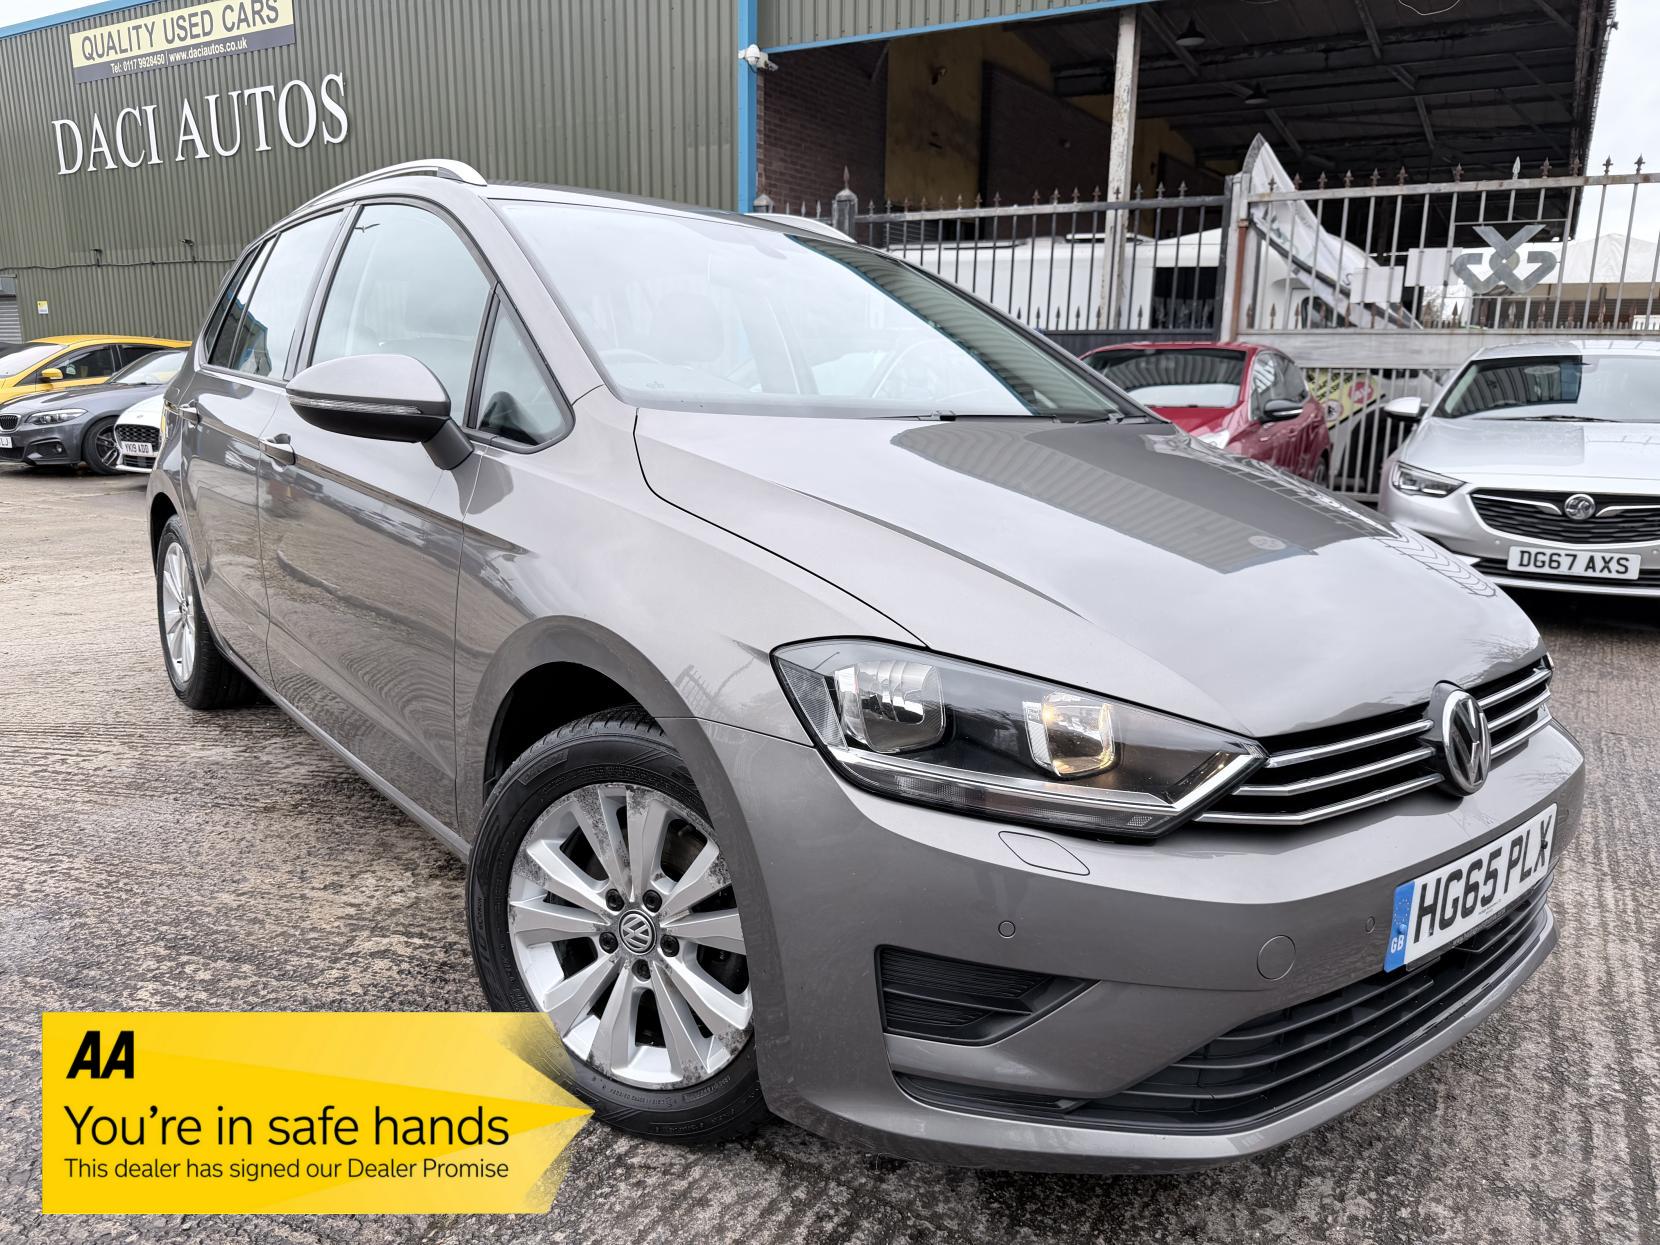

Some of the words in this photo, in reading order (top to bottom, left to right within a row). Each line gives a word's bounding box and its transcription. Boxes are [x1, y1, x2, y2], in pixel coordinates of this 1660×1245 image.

[81, 21, 156, 61] QUALITY
[163, 9, 214, 45] USED
[222, 0, 279, 33] CARS
[110, 63, 122, 74] Tel:
[123, 60, 137, 72] 0117
[168, 37, 248, 62] www.daciautos.co.uk
[51, 104, 163, 175] DACI
[175, 72, 348, 161] AUTOS
[1518, 550, 1578, 571] DG67
[1584, 555, 1630, 575] AXS
[1413, 847, 1503, 945] HG65
[1503, 815, 1553, 894] PLX
[1391, 934, 1405, 953] GB
